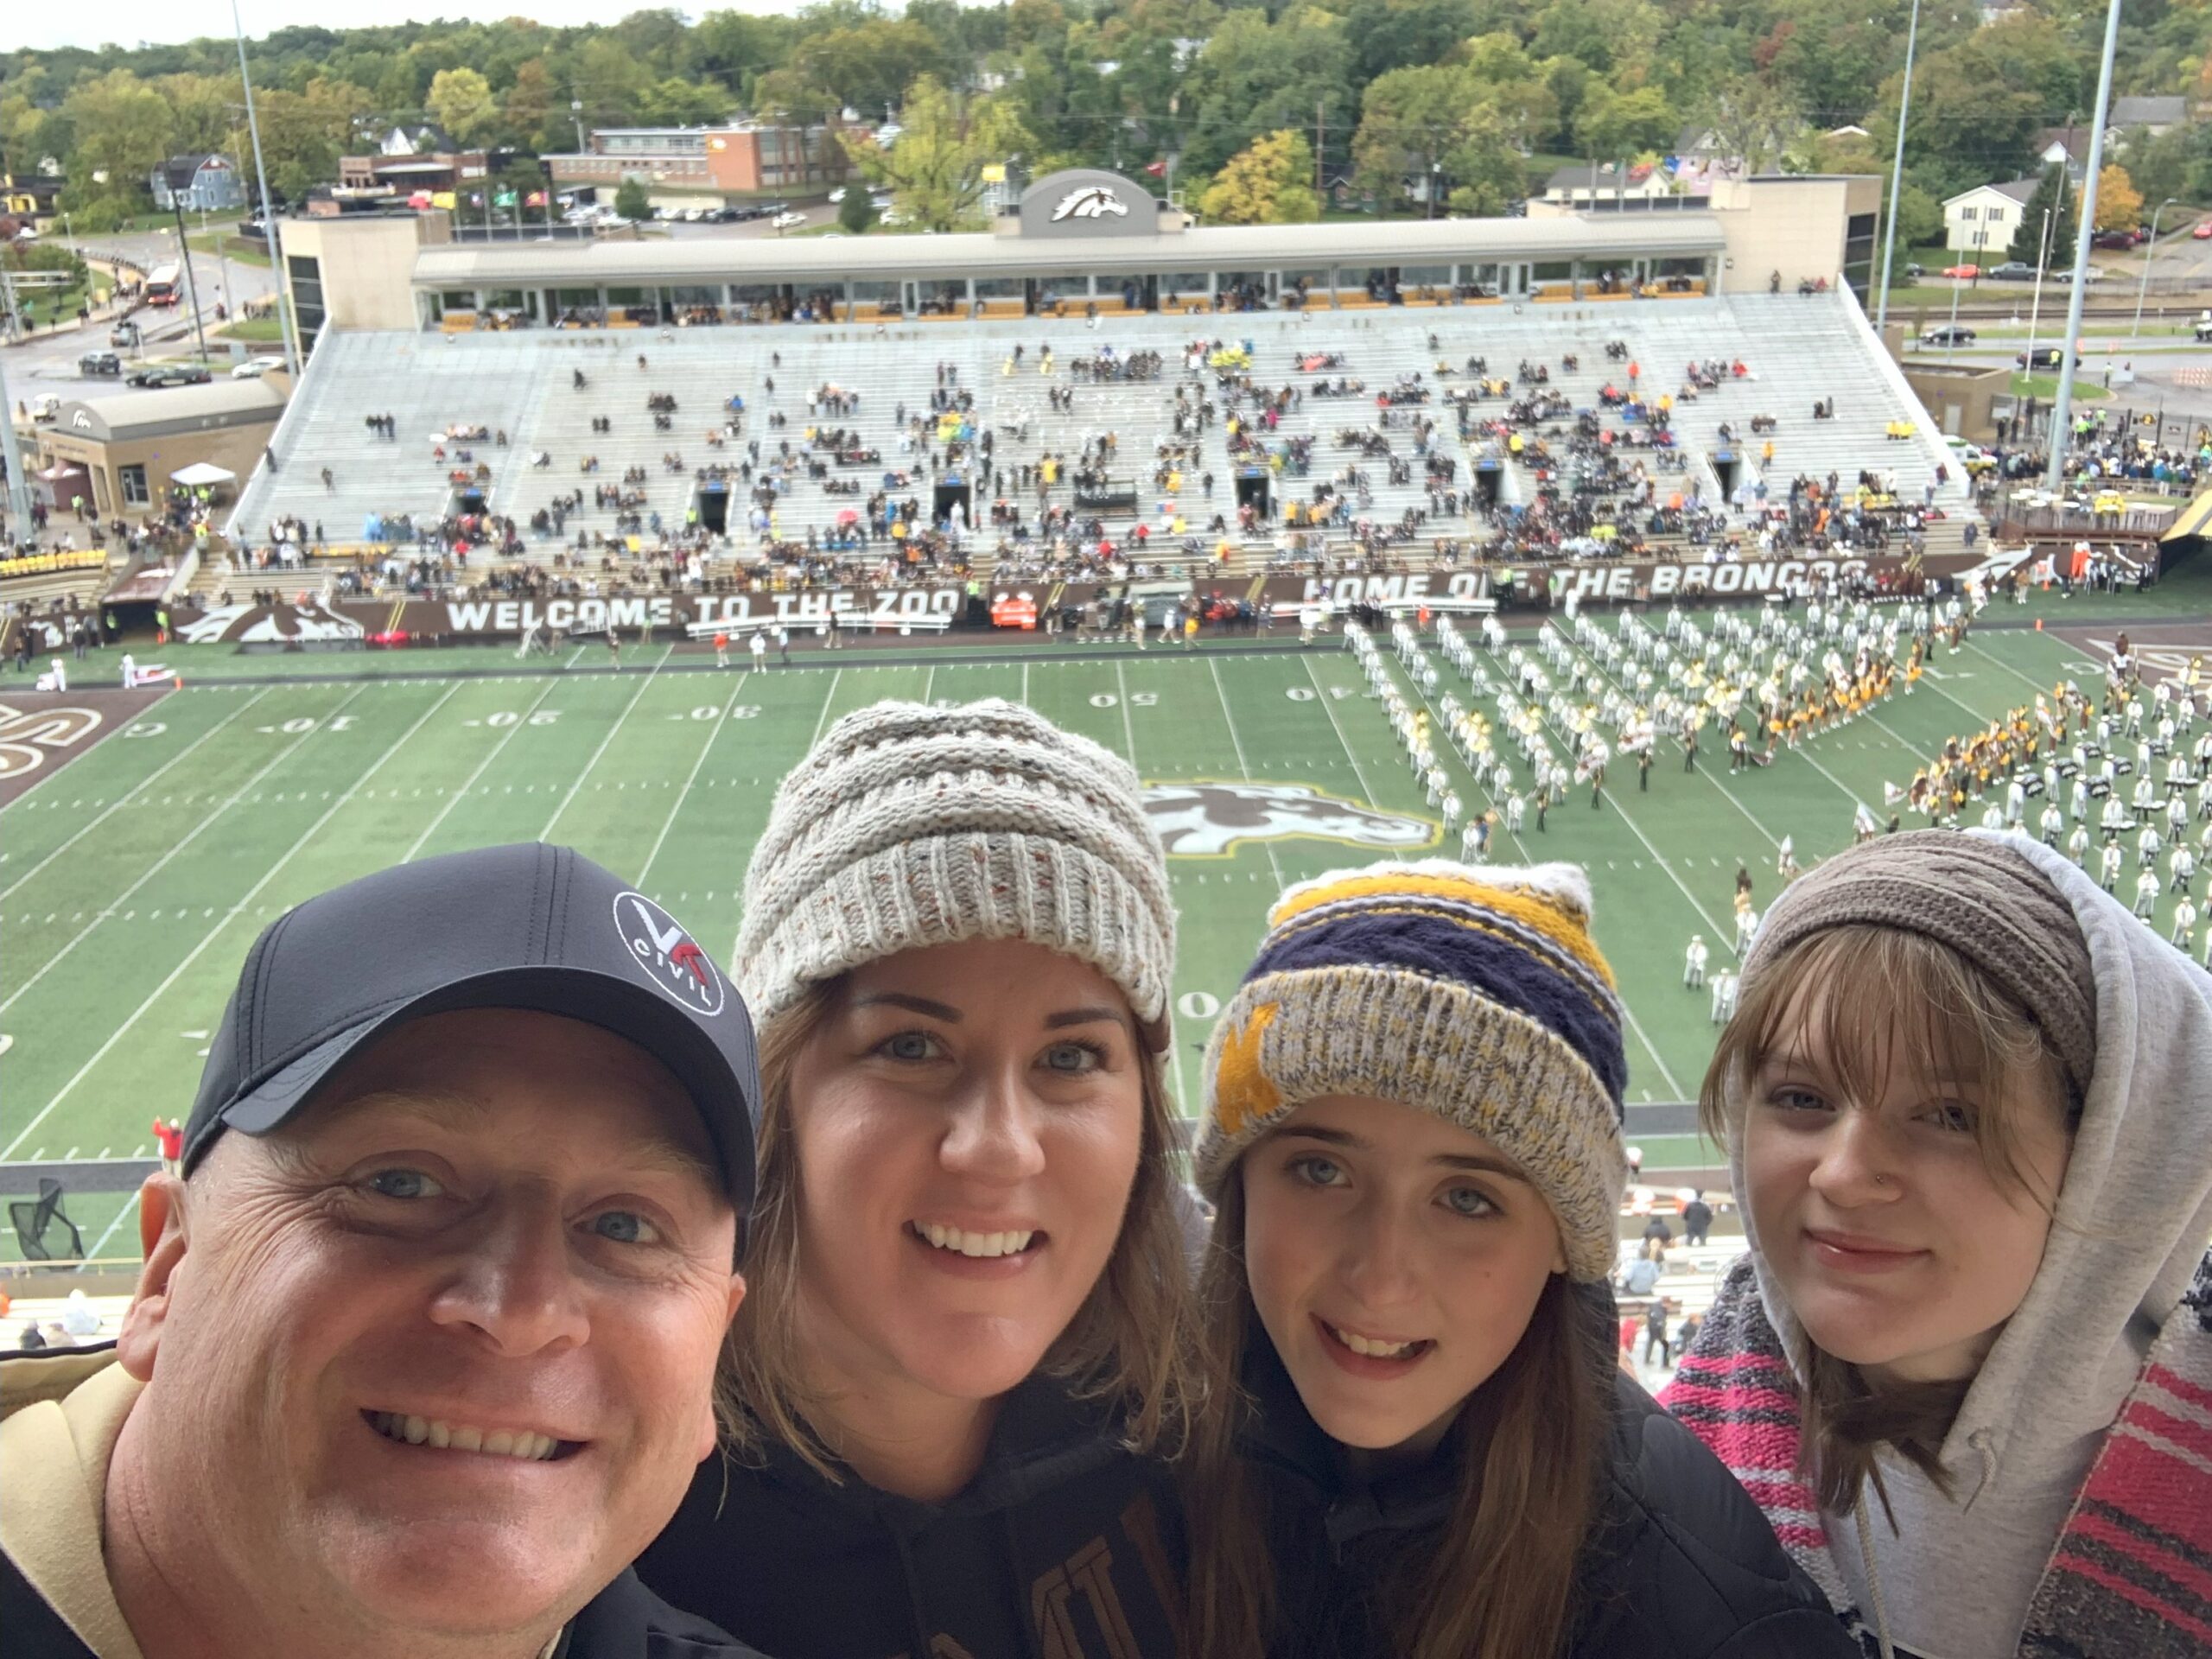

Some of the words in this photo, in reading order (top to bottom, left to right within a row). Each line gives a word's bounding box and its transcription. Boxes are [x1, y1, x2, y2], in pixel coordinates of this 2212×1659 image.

[1303, 572, 1431, 603] HOME
[1552, 567, 1633, 597] THE
[448, 596, 673, 632] WELCOME
[694, 595, 751, 624] TO
[772, 592, 855, 619] THE
[875, 589, 960, 617] ZOO
[1089, 690, 1160, 709] 50
[632, 937, 712, 1007] CIVIL
